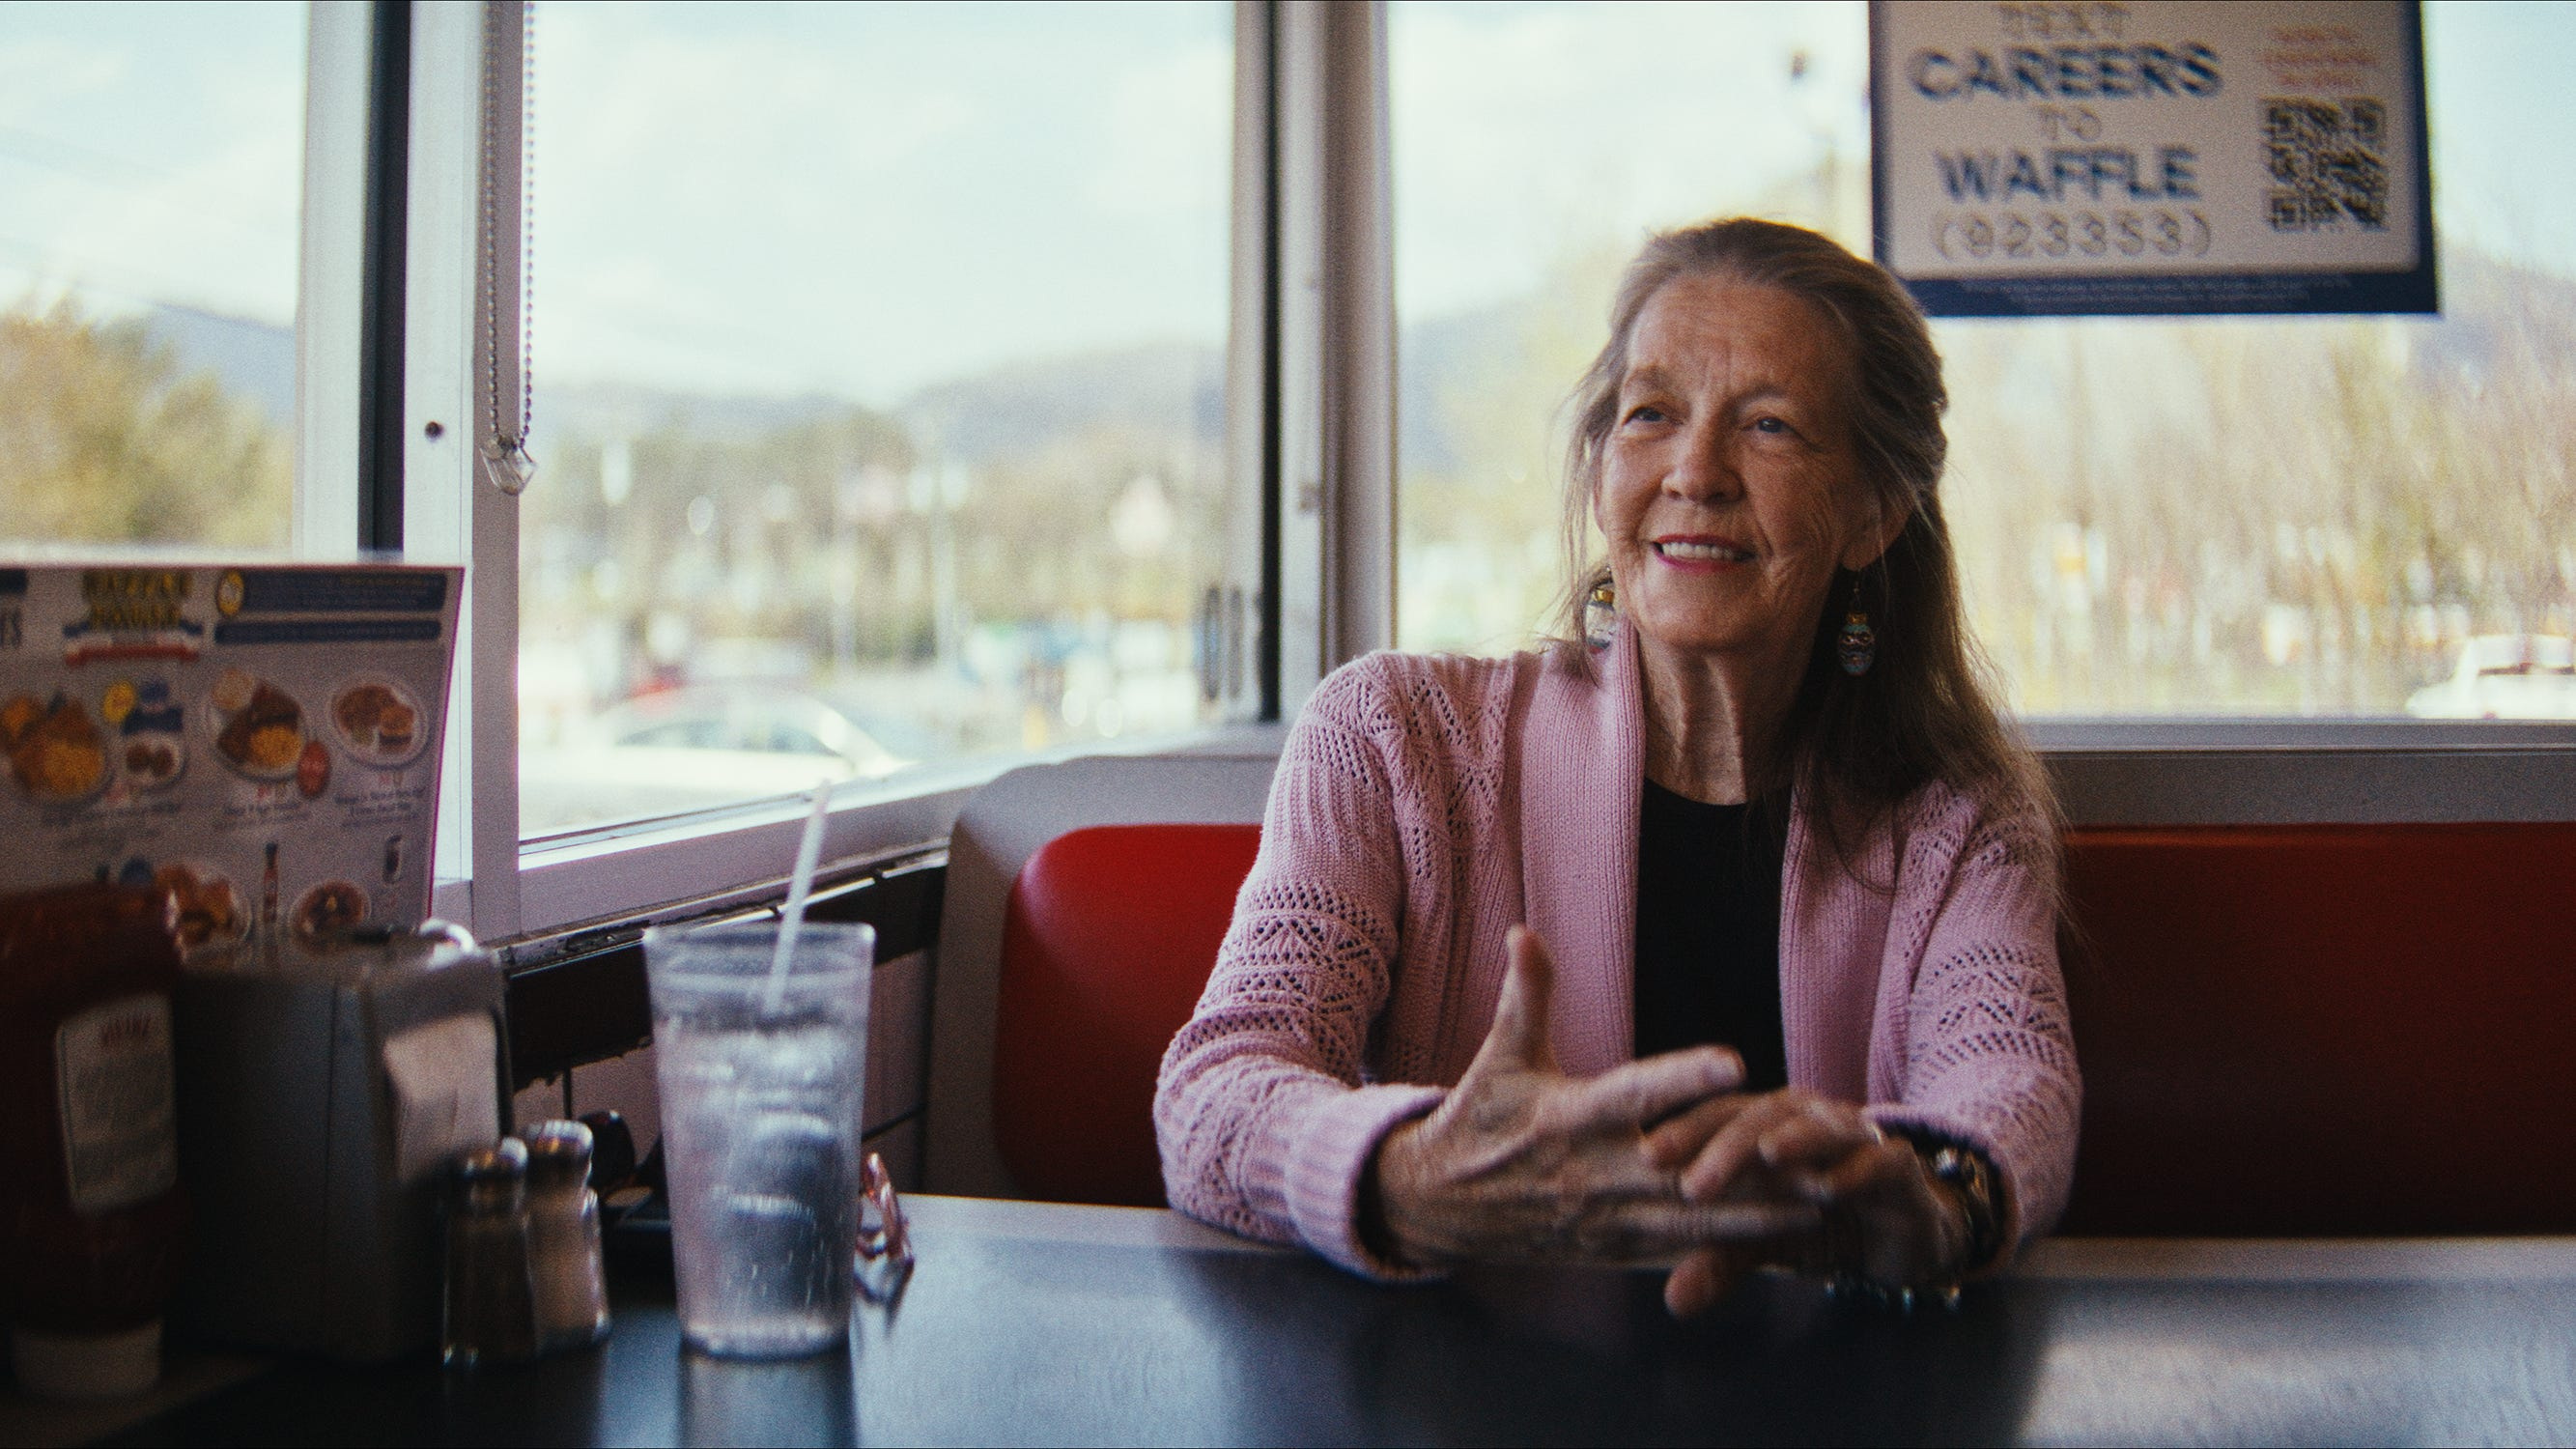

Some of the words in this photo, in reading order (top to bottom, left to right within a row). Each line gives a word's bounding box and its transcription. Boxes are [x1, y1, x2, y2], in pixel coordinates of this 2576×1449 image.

[1907, 42, 2222, 101] CAREERS
[2032, 103, 2103, 142] TO
[1935, 147, 2201, 203] WAFFLE
